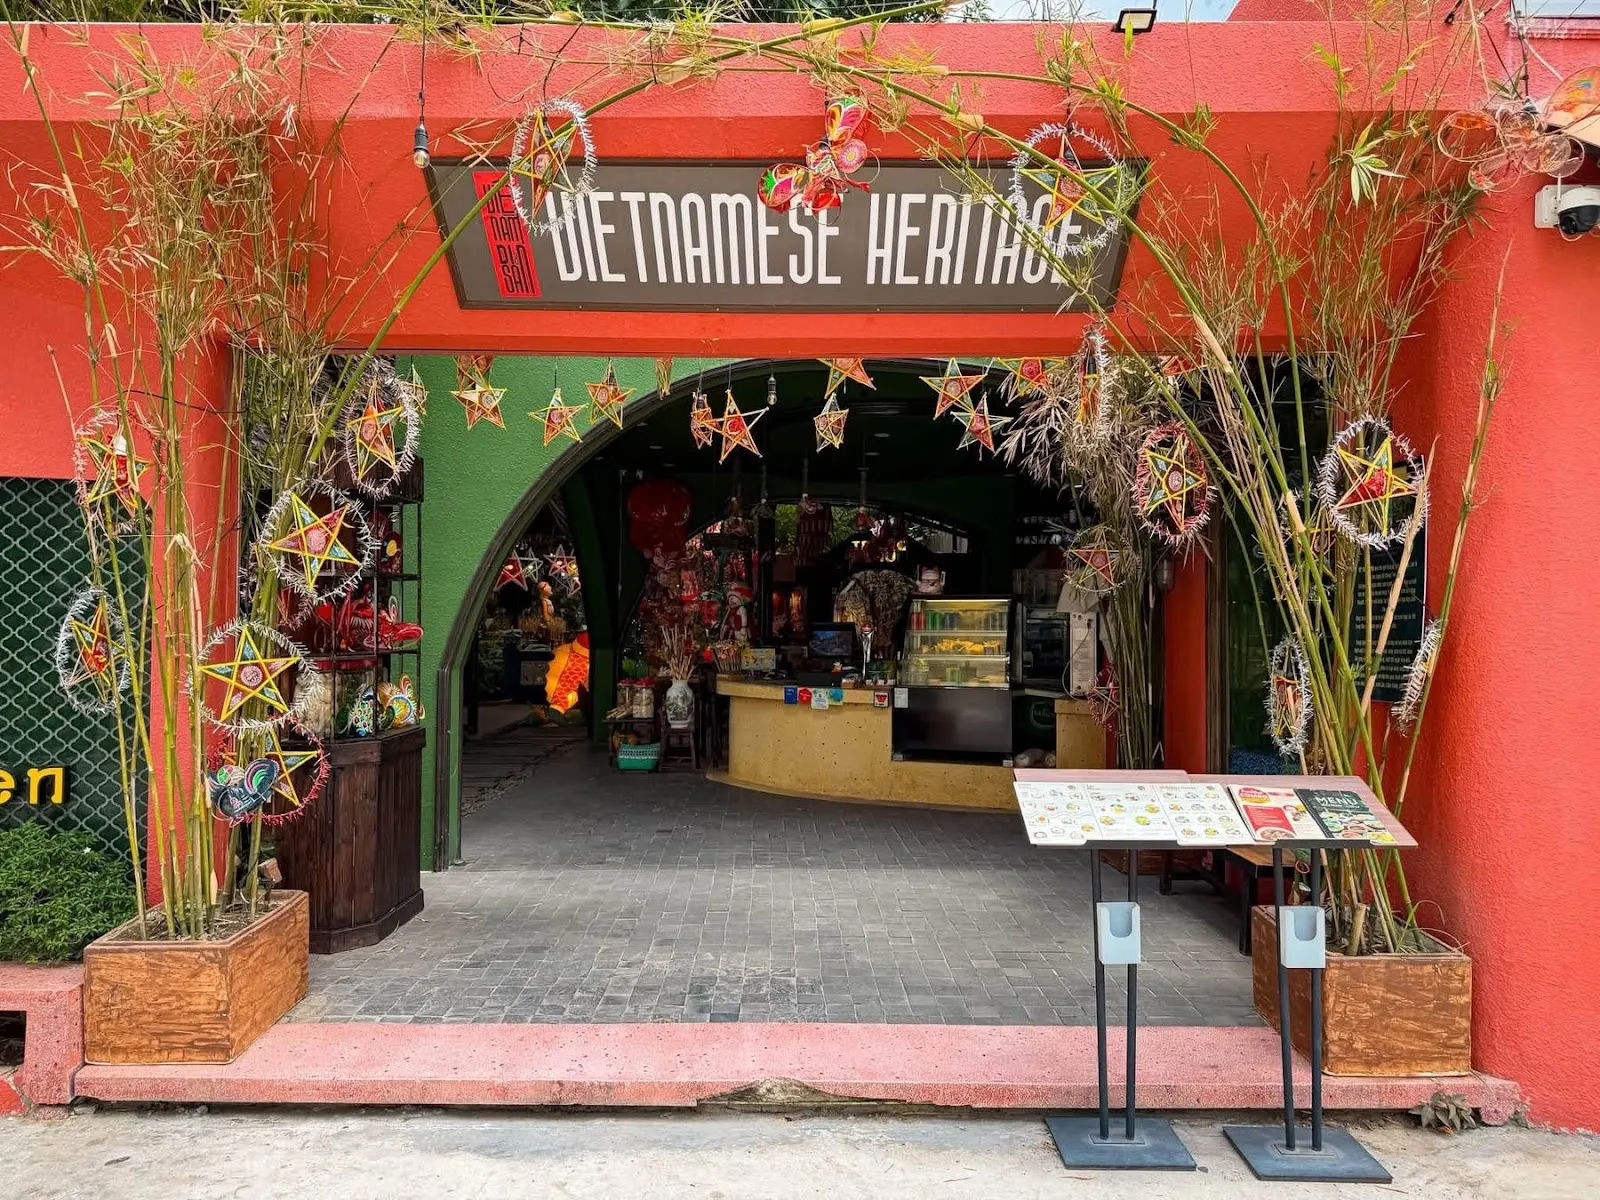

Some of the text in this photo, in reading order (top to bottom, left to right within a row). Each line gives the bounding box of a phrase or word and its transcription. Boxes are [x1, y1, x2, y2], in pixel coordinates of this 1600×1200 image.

[490, 216, 524, 244] NAM
[545, 191, 843, 285] VIETNAMESE
[1315, 796, 1358, 806] MENU
